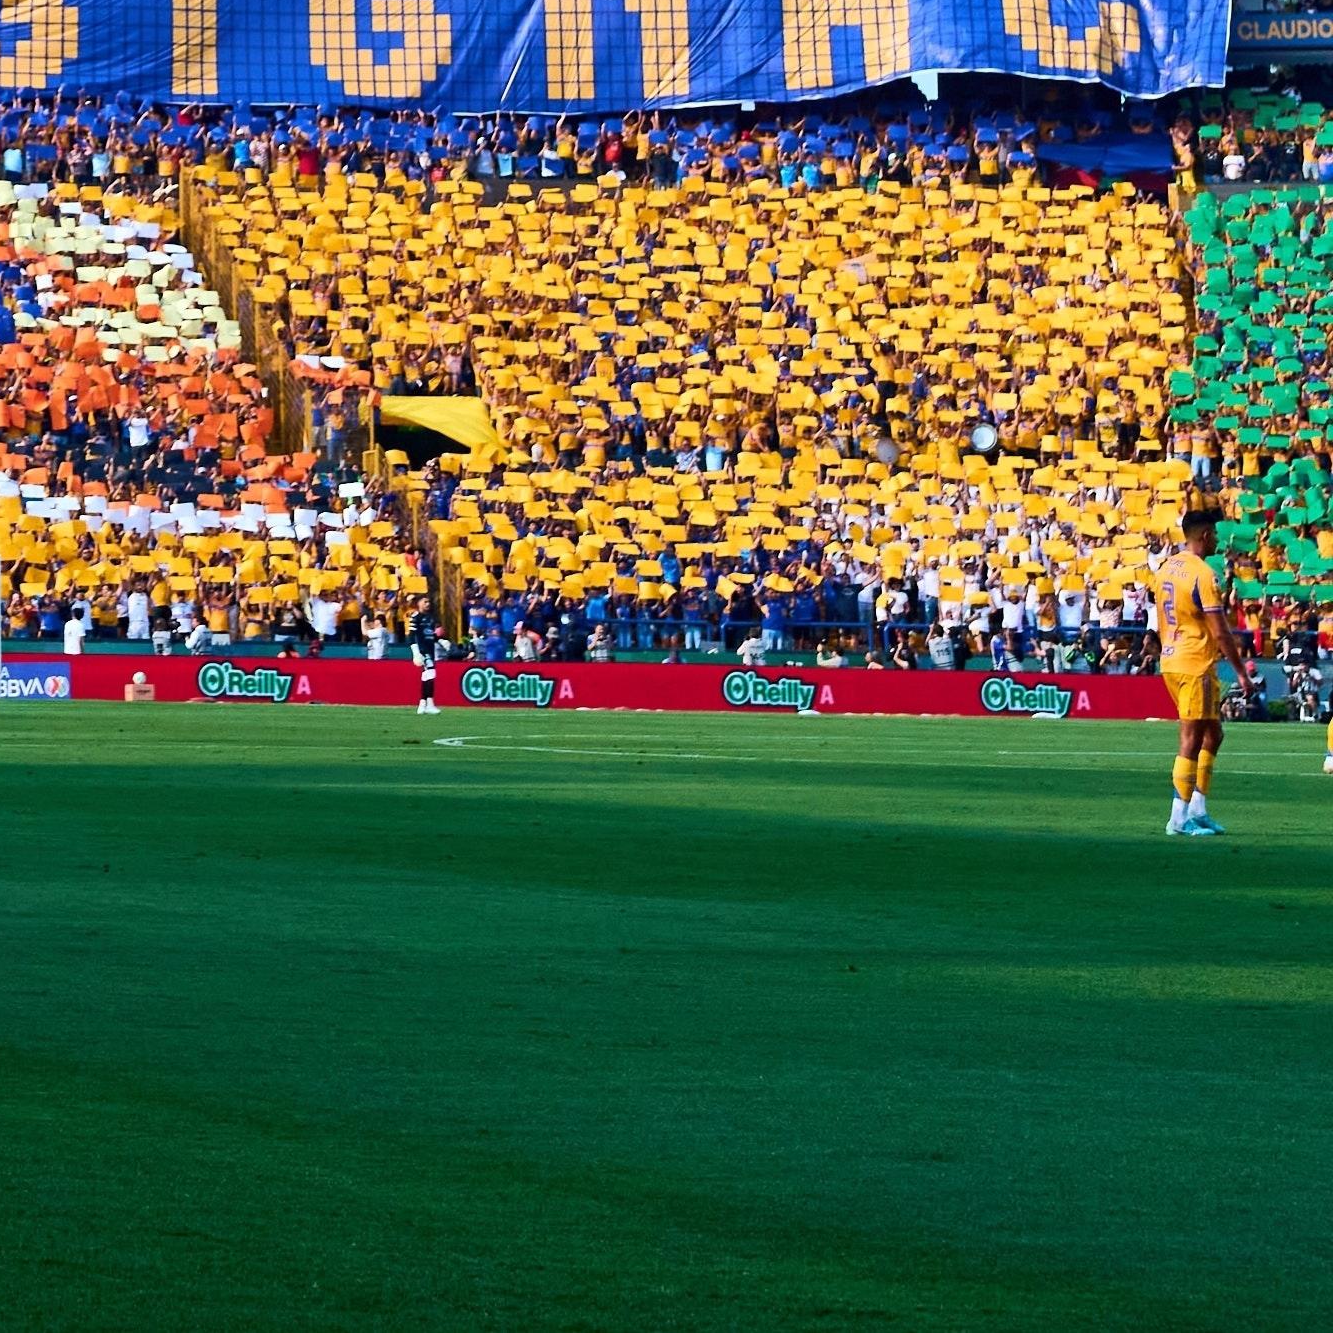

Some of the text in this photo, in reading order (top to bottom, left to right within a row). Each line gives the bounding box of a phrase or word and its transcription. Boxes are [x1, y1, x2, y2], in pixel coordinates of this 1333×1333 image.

[1237, 19, 1333, 41] CLAUDIO
[198, 662, 312, 702] O'Reilly A
[462, 667, 574, 706] O'Reilly A
[723, 671, 834, 710] O'Reilly A
[981, 677, 1091, 715] O'Reilly A
